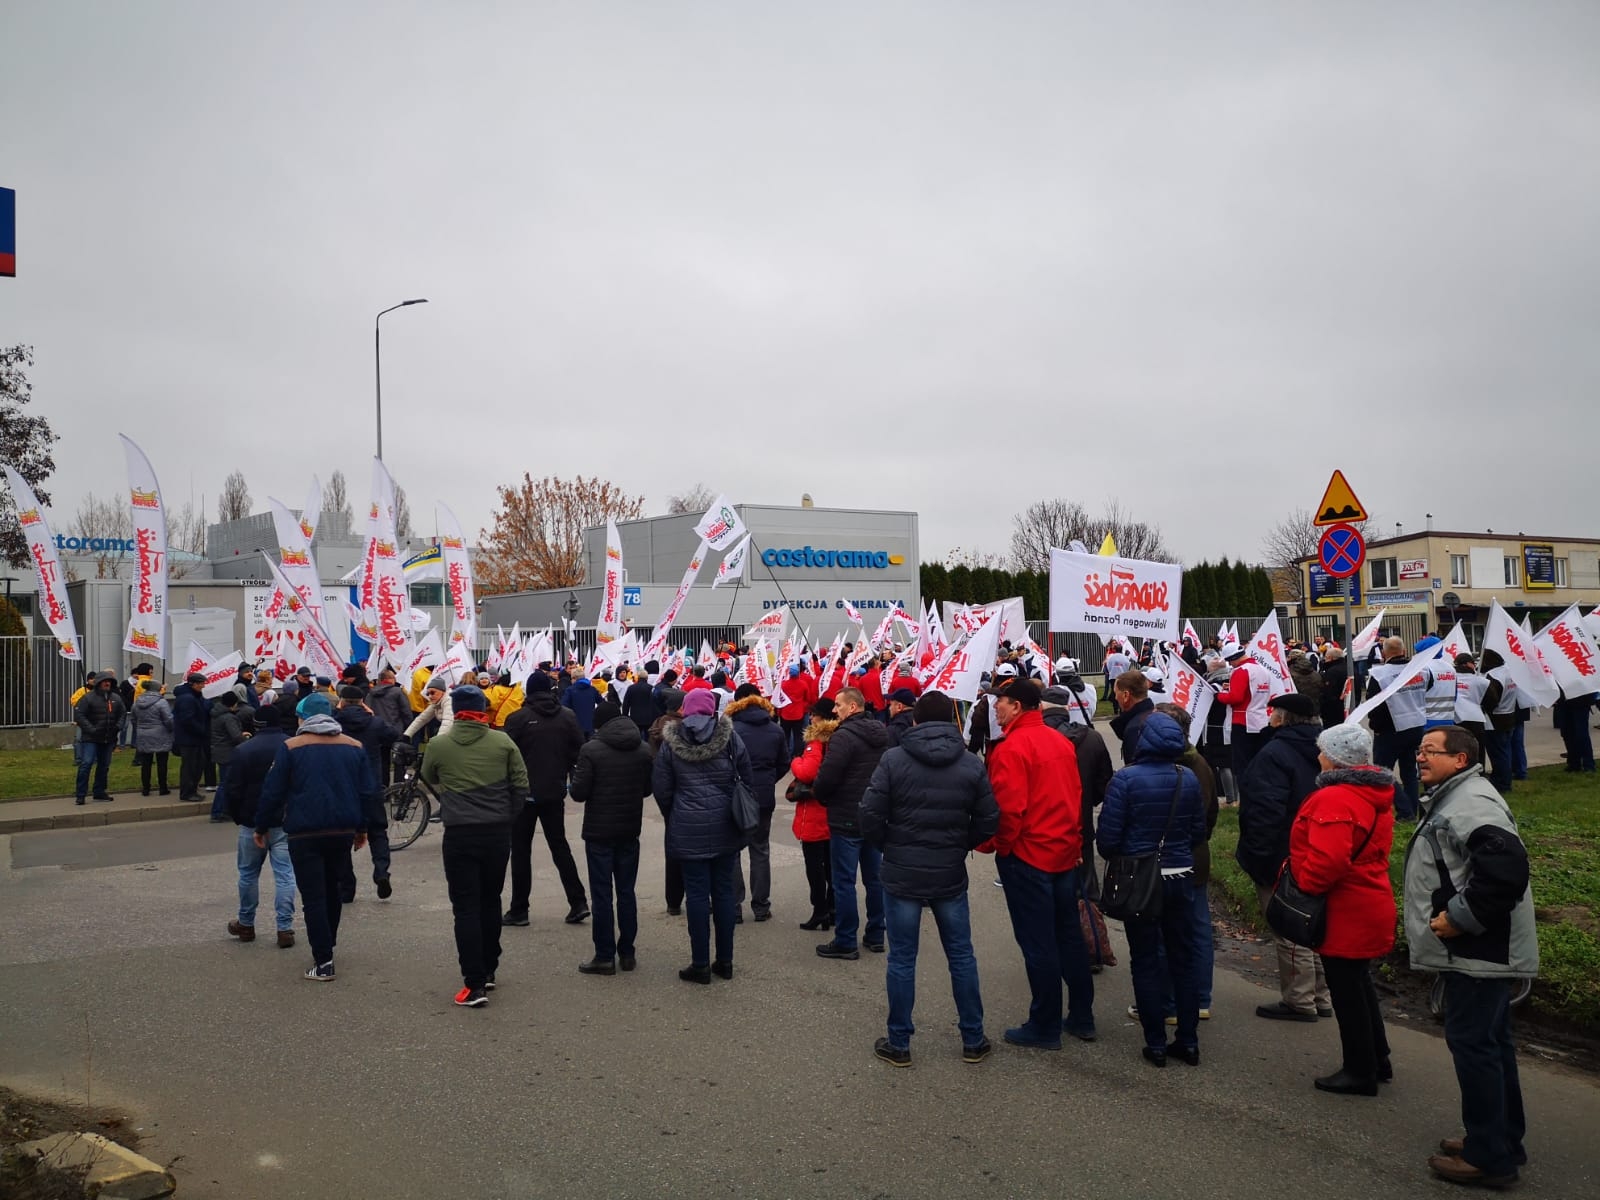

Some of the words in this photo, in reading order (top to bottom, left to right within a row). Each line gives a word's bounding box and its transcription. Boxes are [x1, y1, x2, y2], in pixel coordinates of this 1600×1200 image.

[762, 546, 888, 568] castorama
[624, 593, 641, 604] 78
[836, 600, 905, 609] GNERALA
[1250, 650, 1282, 679] Volkswag
